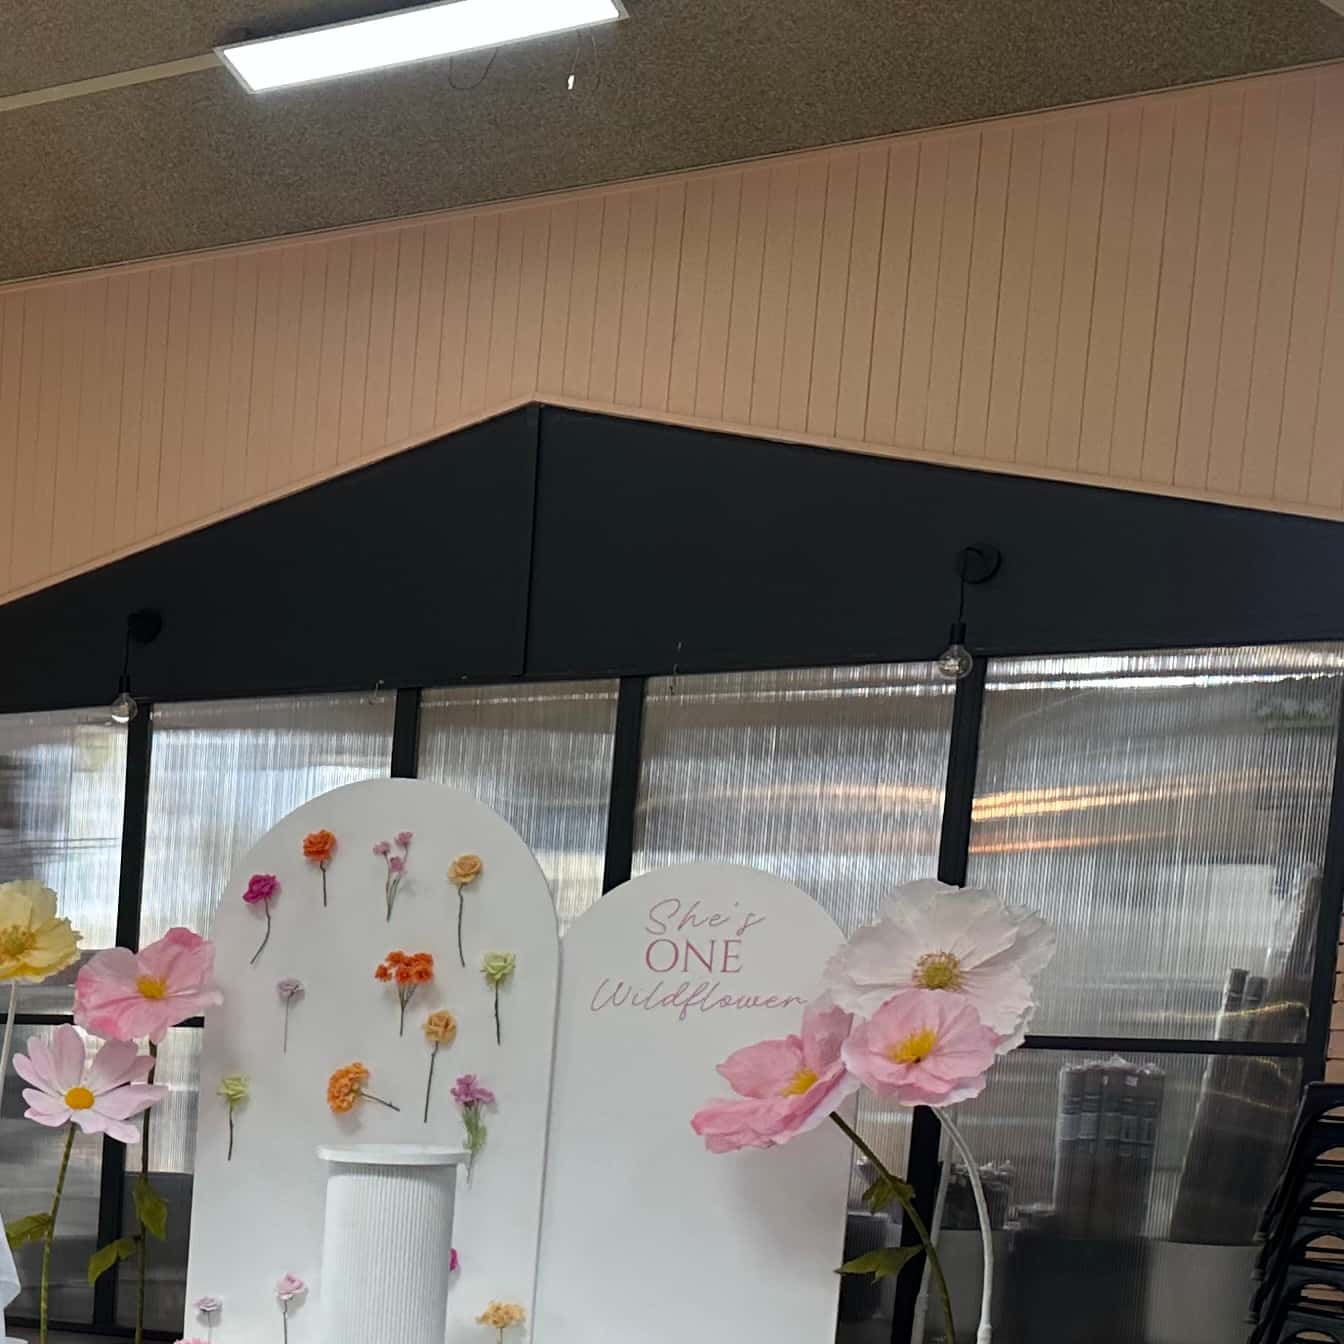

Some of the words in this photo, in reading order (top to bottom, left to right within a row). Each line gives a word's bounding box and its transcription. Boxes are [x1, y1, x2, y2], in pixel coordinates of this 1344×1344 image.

[644, 899, 766, 936] She's
[646, 939, 743, 973] ONE
[591, 978, 808, 1021] Wildflower
